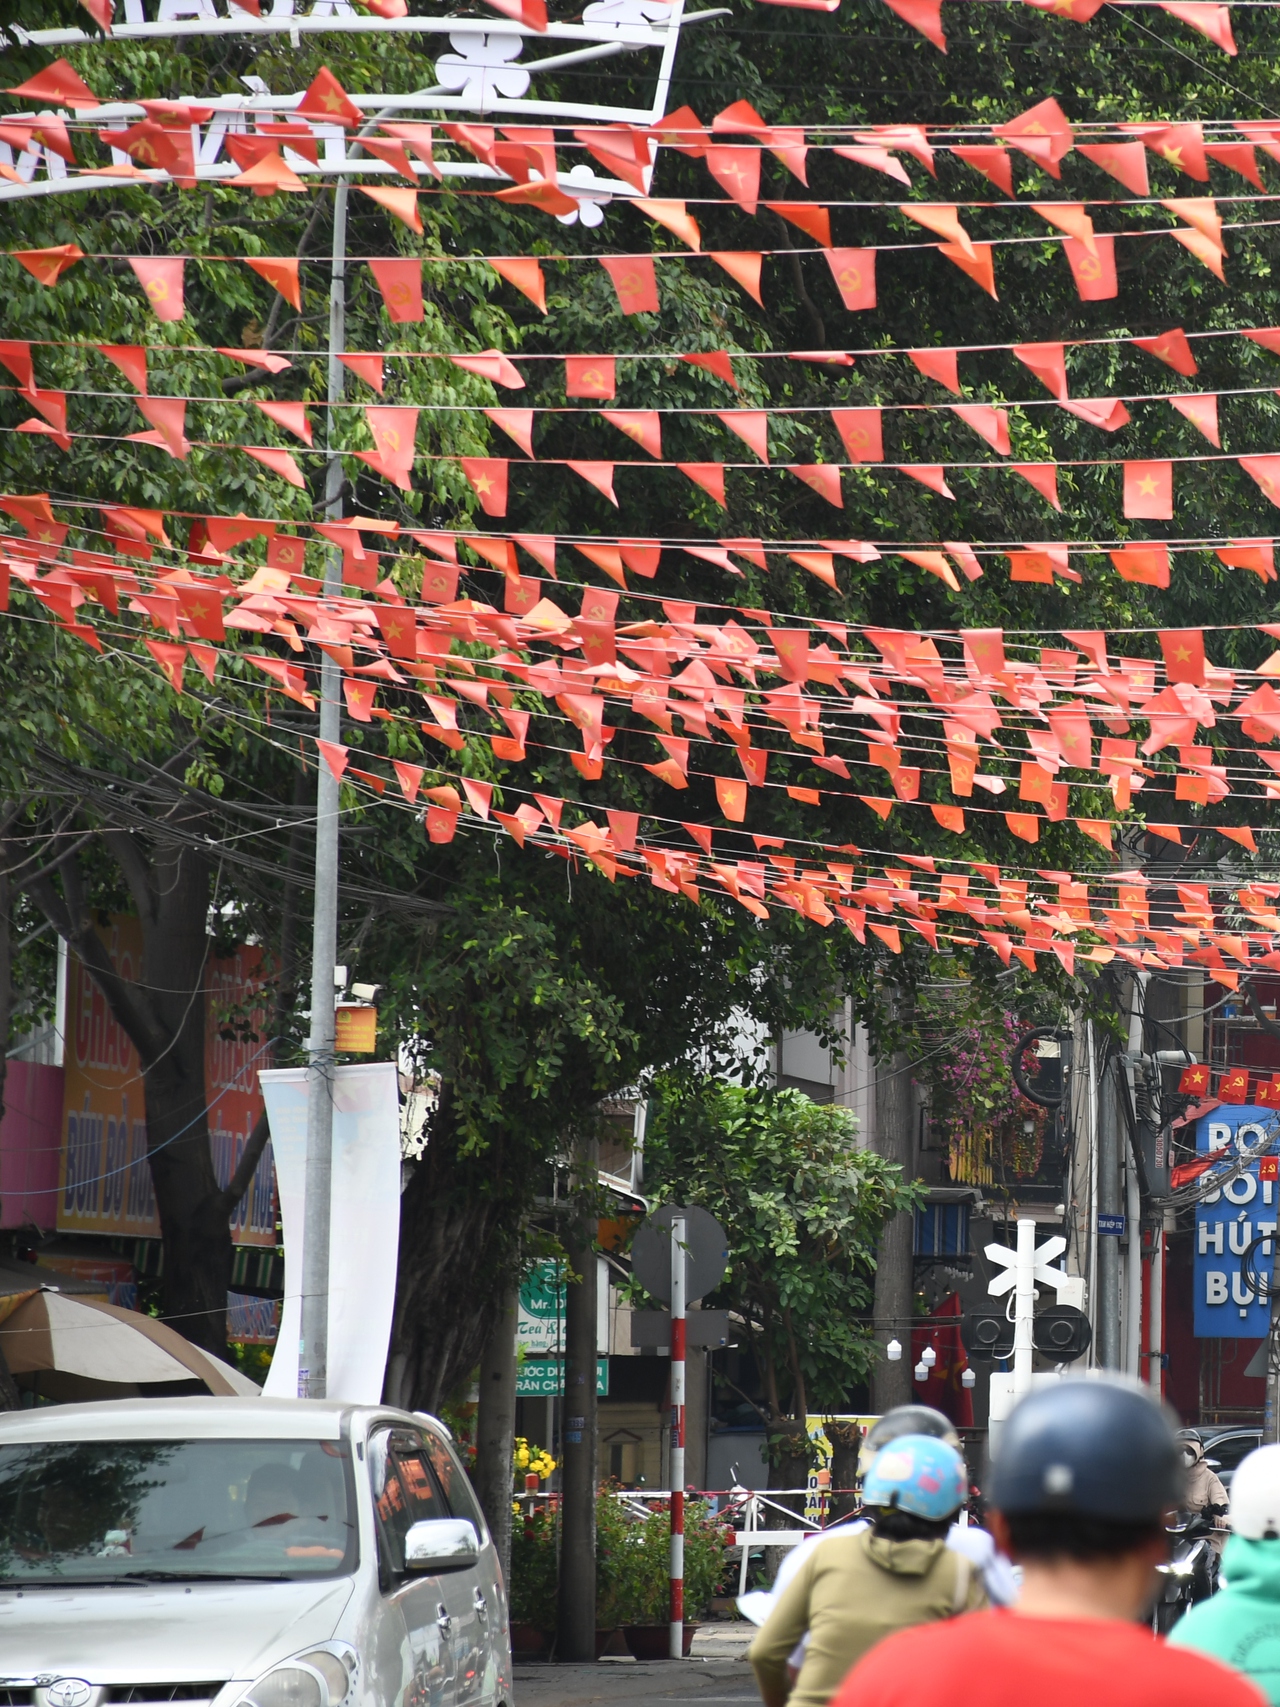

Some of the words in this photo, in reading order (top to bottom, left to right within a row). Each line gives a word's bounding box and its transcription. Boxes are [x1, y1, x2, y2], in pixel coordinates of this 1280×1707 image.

[1208, 1123, 1268, 1156] RO
[1198, 1210, 1277, 1255] HÚT
[1206, 1271, 1268, 1318] BỤI
[517, 1321, 542, 1334] Tea
[516, 1379, 540, 1391] RÂN
